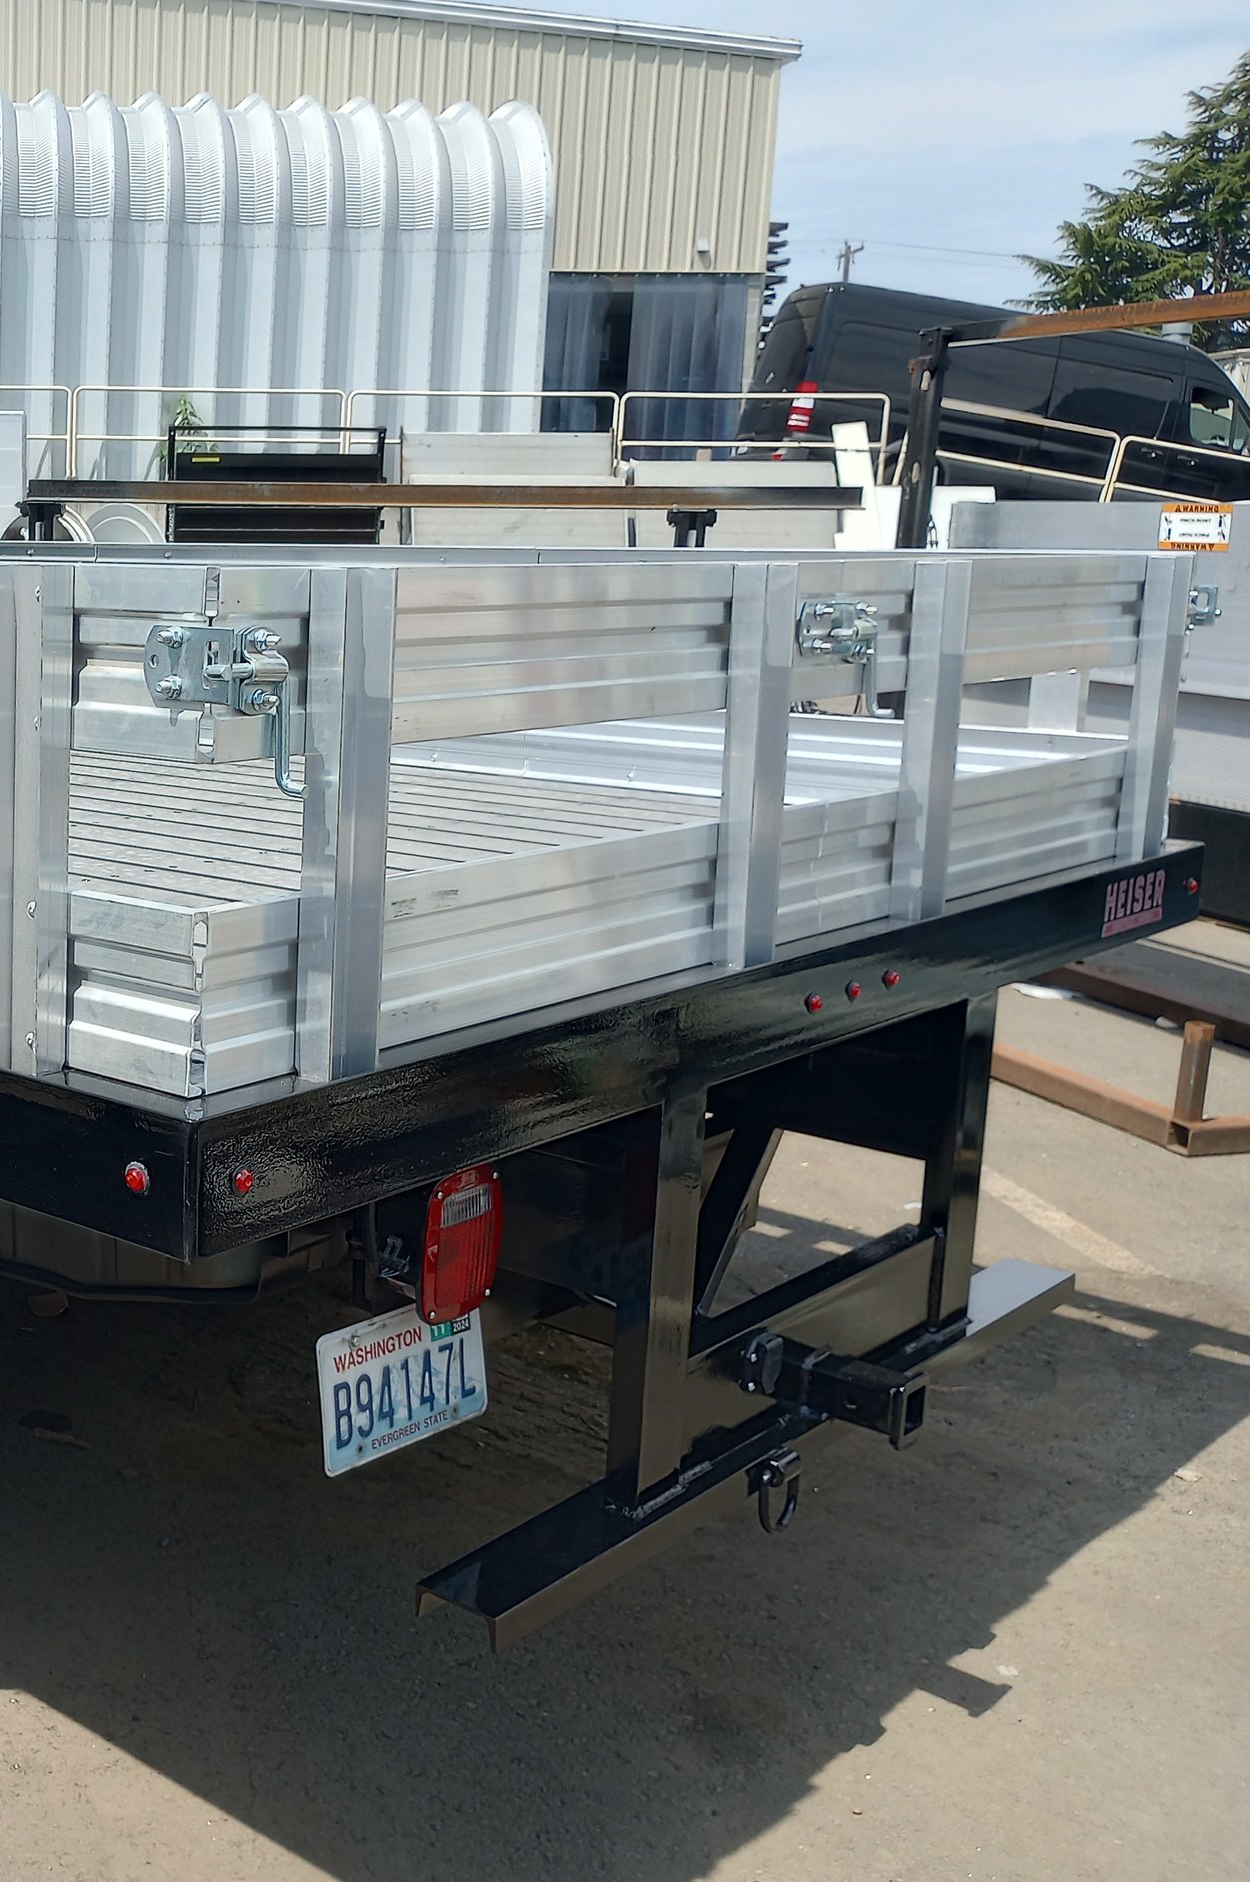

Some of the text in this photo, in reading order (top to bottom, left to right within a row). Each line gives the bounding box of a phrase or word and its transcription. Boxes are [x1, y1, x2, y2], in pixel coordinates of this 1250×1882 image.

[1182, 505, 1219, 513] WARNING
[1103, 869, 1166, 922] HEISER
[453, 1318, 469, 1332] 2024
[333, 1326, 422, 1374] WASHINGTON
[333, 1338, 476, 1450] B94147L
[372, 1411, 448, 1450] EVERGREEN STATE
